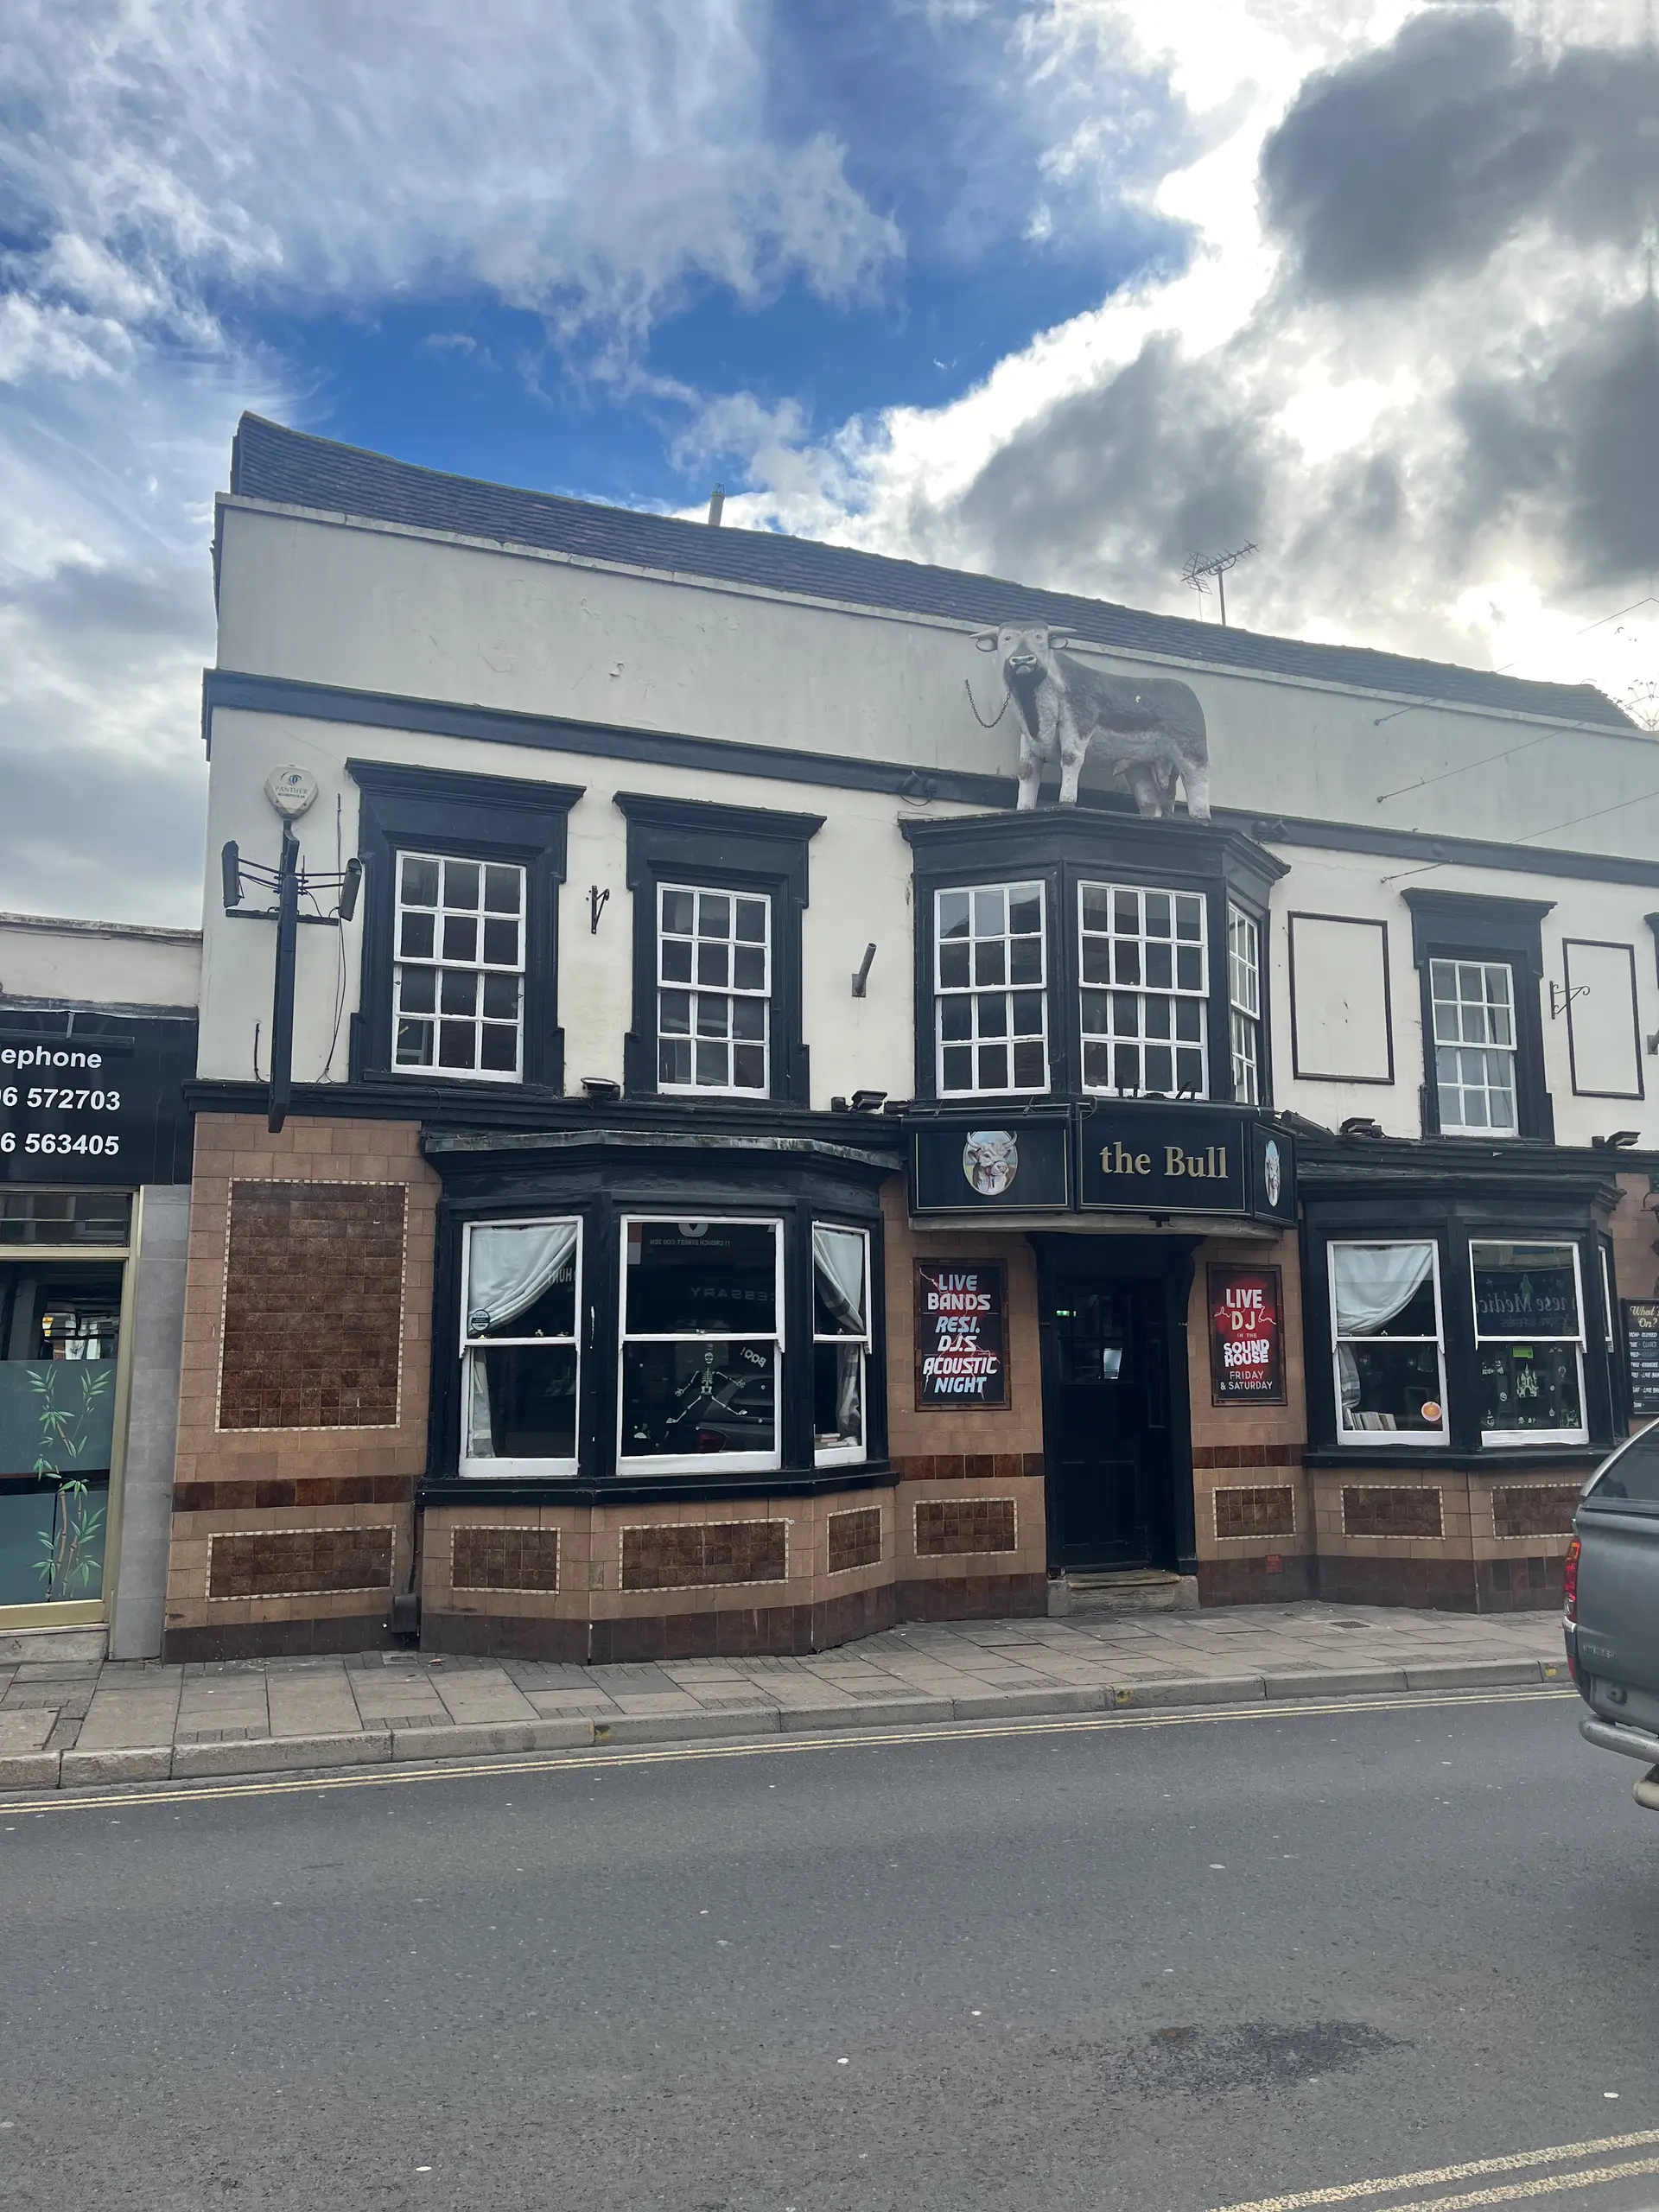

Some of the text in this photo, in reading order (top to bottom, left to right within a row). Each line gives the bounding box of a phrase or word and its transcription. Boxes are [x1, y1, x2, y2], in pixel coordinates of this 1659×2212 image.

[276, 785, 308, 795] PANTHER
[1, 1046, 102, 1070] ephone
[0, 1087, 120, 1110] 6 572703
[24, 1134, 119, 1155] 563405
[1099, 1141, 1229, 1179] the Bull
[938, 1274, 978, 1291] LIVE
[928, 1293, 990, 1310] BANDS
[1226, 1289, 1262, 1308] LIVE
[935, 1316, 980, 1334] RESI.
[1231, 1311, 1255, 1331] DJ
[1637, 1317, 1657, 1327] On?
[1224, 1339, 1270, 1355] SOUND
[923, 1357, 997, 1375] ACOUSTIC
[1224, 1351, 1268, 1367] HOUSE
[1230, 1370, 1263, 1380] FRIDAY
[935, 1376, 987, 1393] NIGHT
[1220, 1382, 1226, 1390] &
